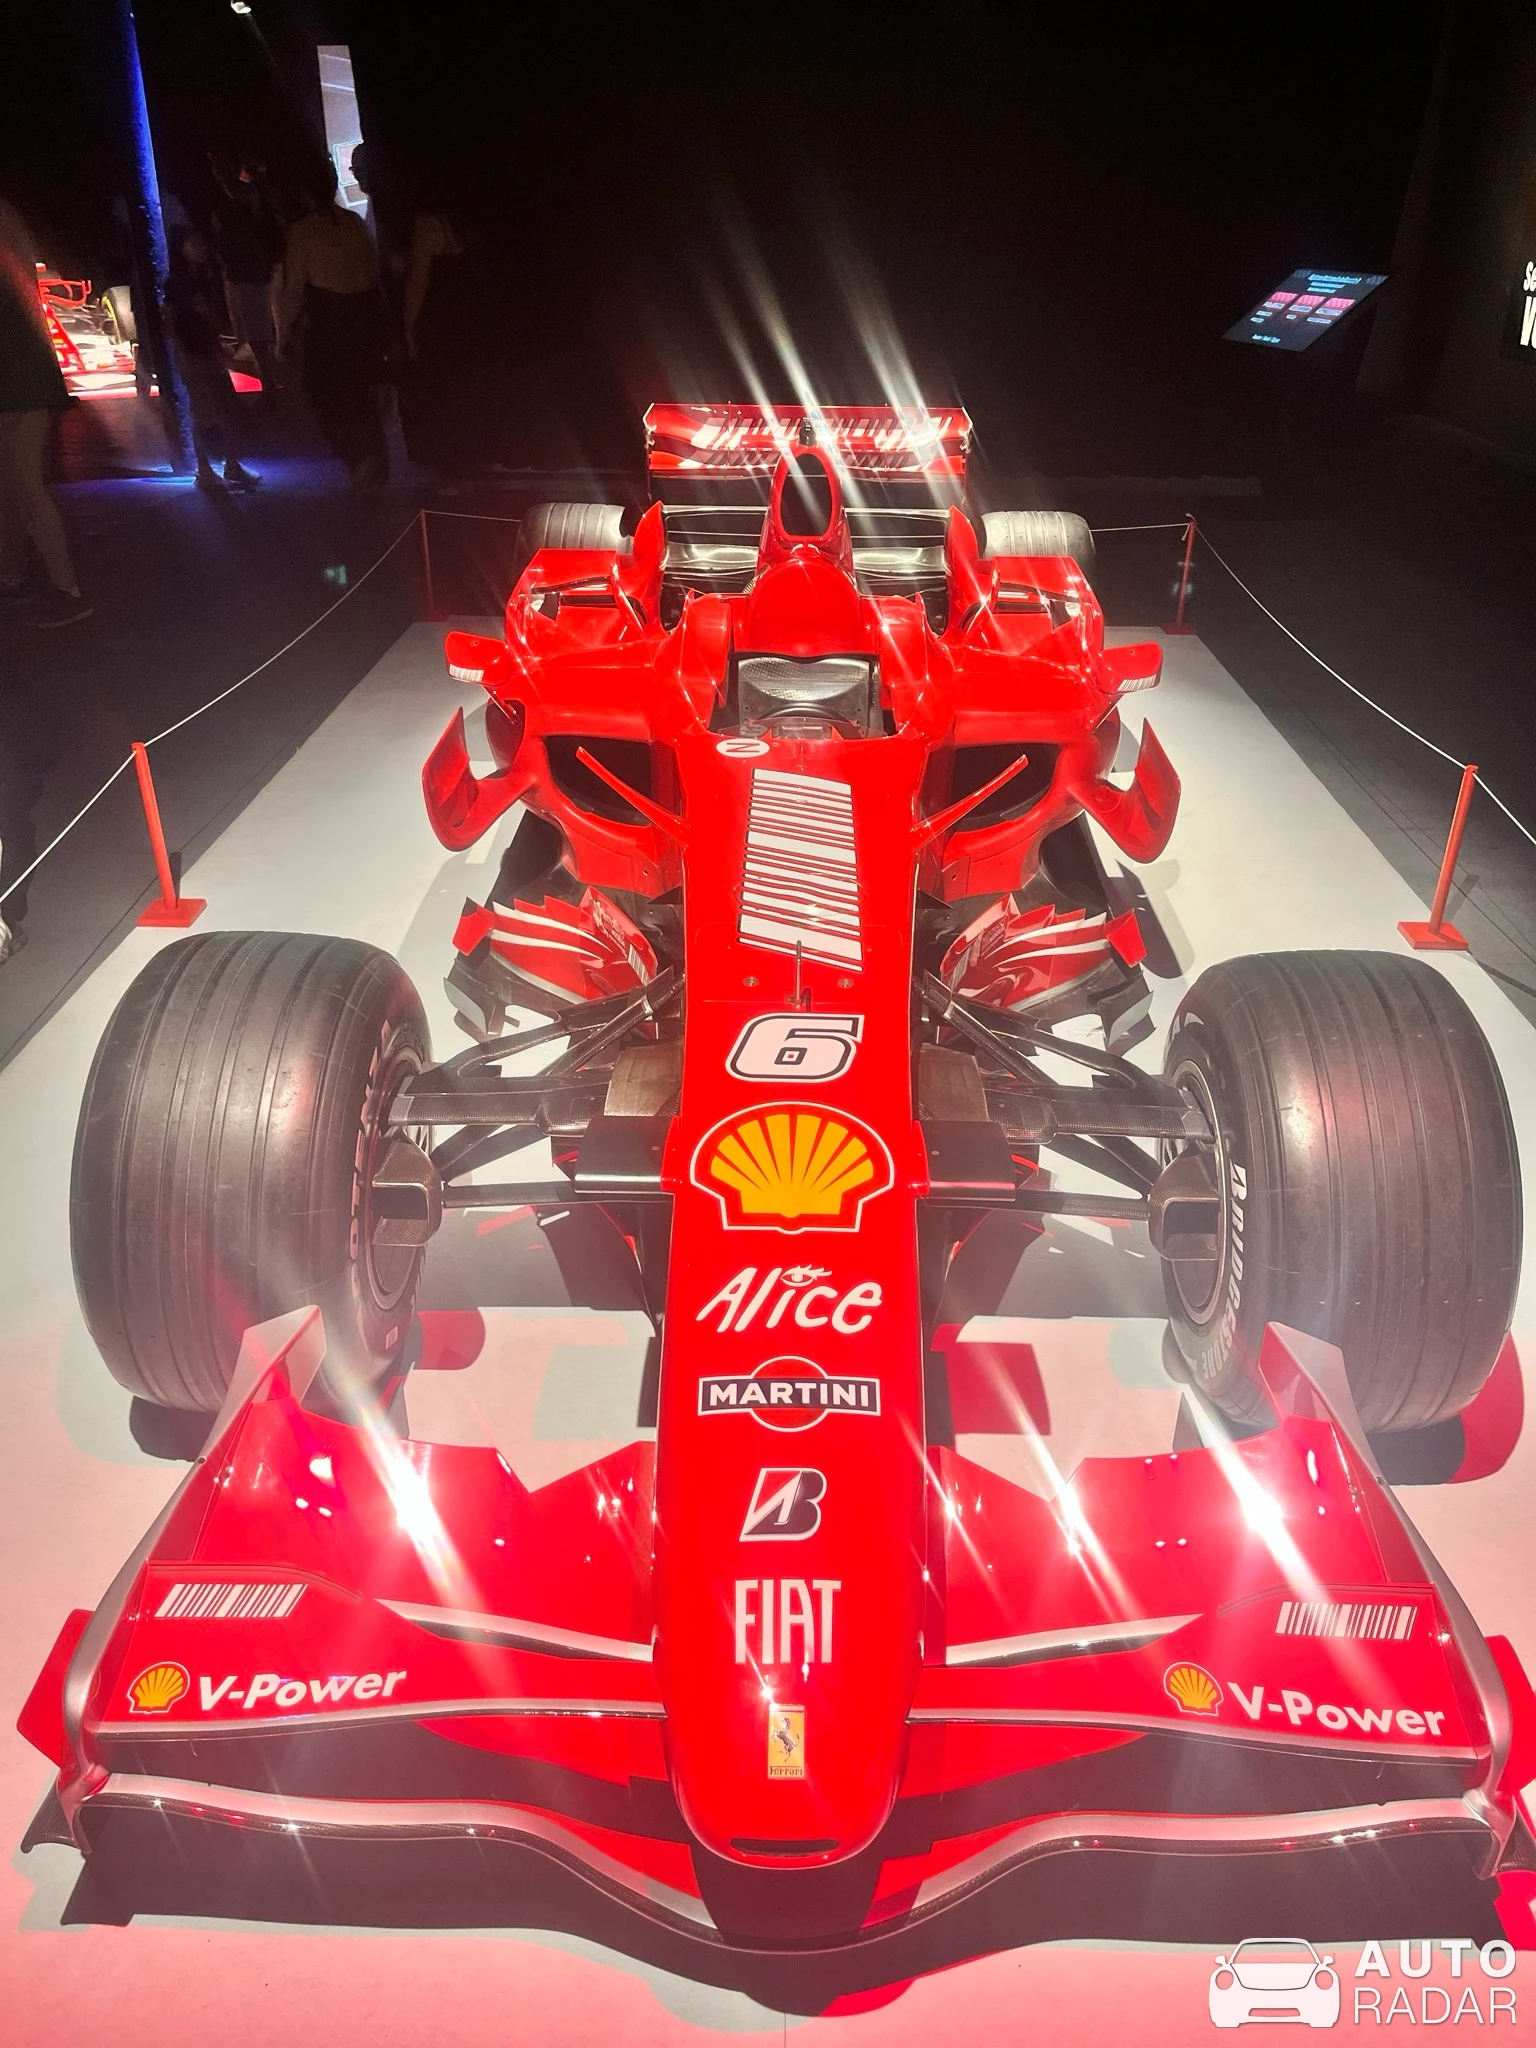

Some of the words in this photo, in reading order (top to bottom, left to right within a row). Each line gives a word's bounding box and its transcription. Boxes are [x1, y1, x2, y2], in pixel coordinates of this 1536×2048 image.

[725, 1012, 865, 1083] 6
[696, 1264, 883, 1335] Alice
[1202, 1157, 1248, 1381] BRIDGESTONE
[709, 1382, 870, 1407] MARTINI
[735, 1578, 842, 1664] FIAT
[200, 1670, 408, 1711] V-Power
[1227, 1681, 1445, 1736] V-Power
[769, 1765, 804, 1777] Ferrari
